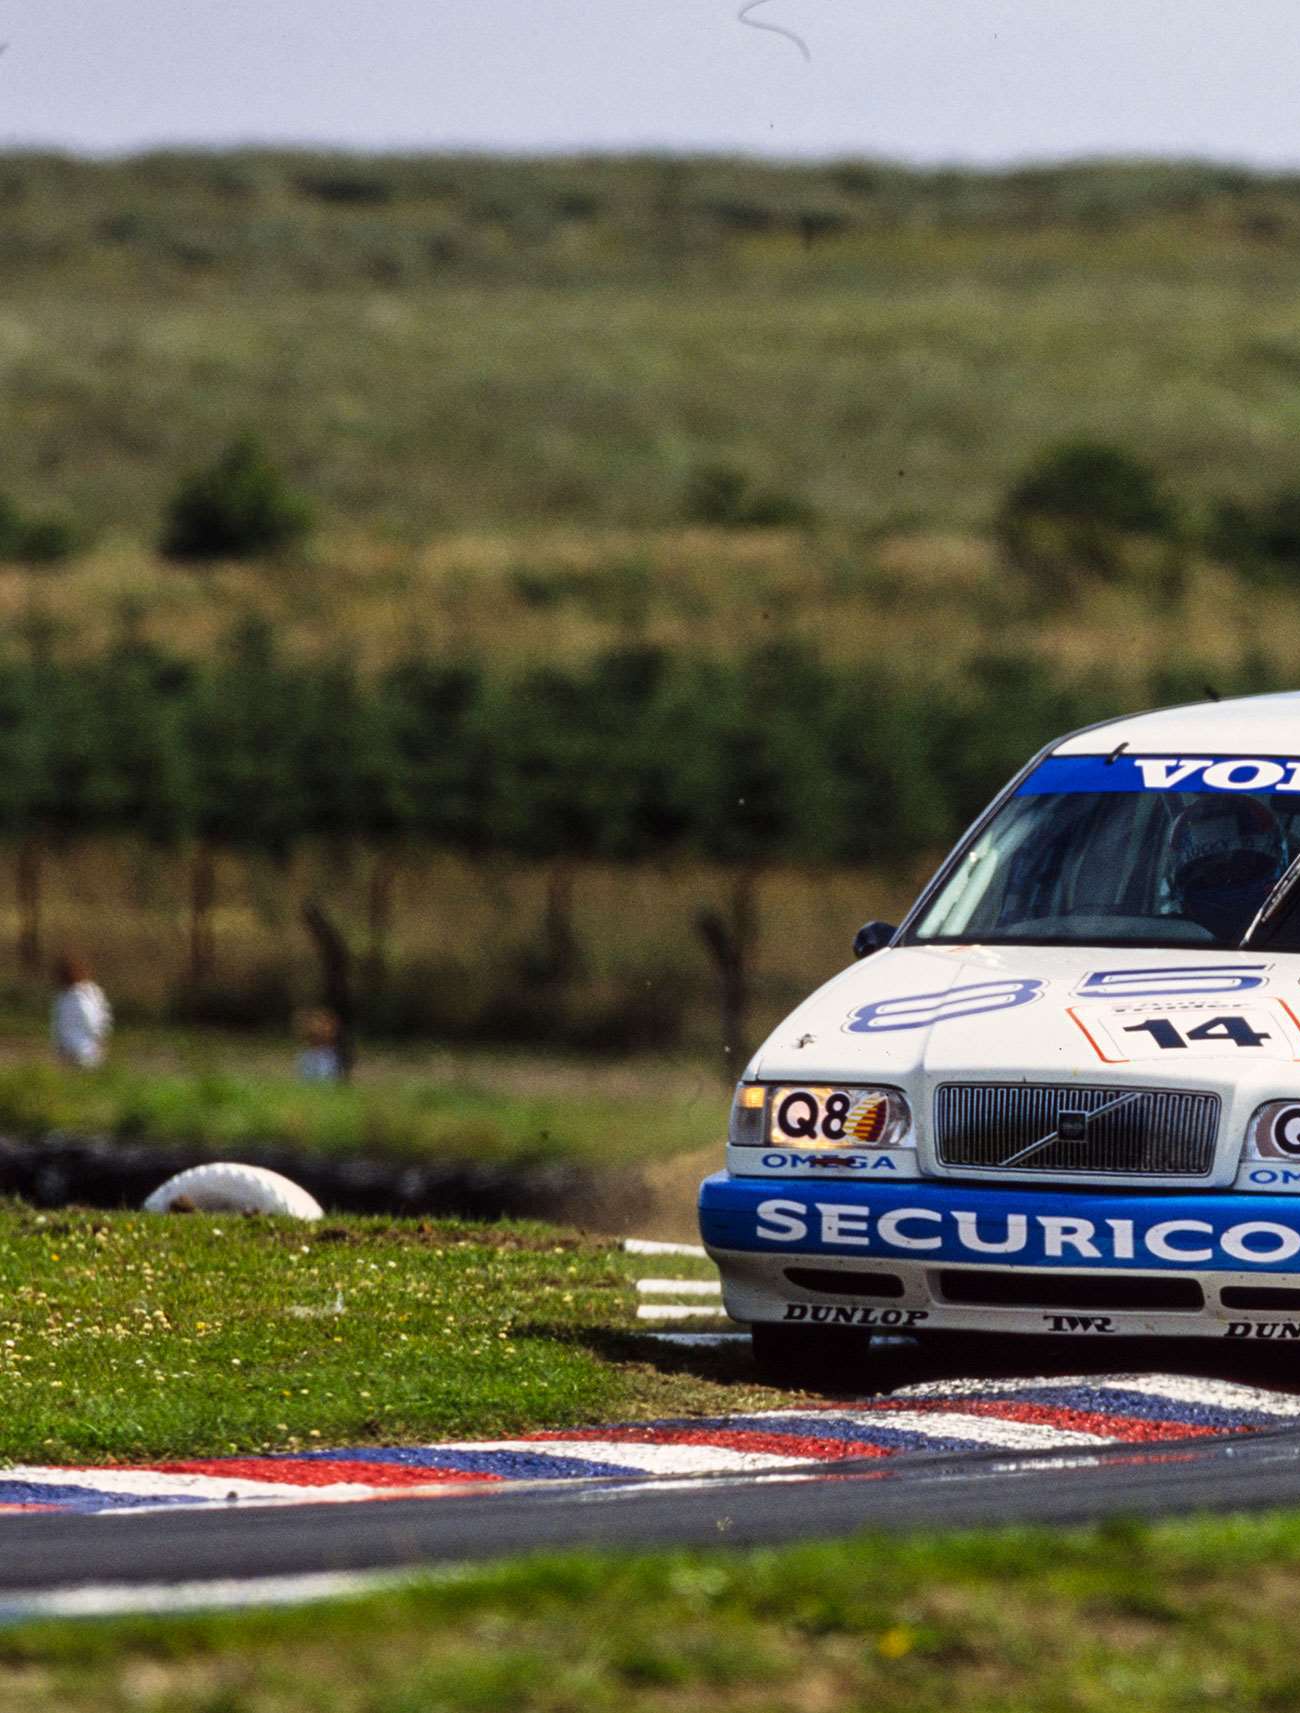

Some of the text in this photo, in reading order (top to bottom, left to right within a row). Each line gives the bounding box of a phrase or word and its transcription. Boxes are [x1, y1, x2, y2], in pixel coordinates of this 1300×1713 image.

[1123, 1016, 1272, 1049] 14
[777, 1091, 850, 1140] Q8
[783, 1303, 929, 1327] DUNLOP
